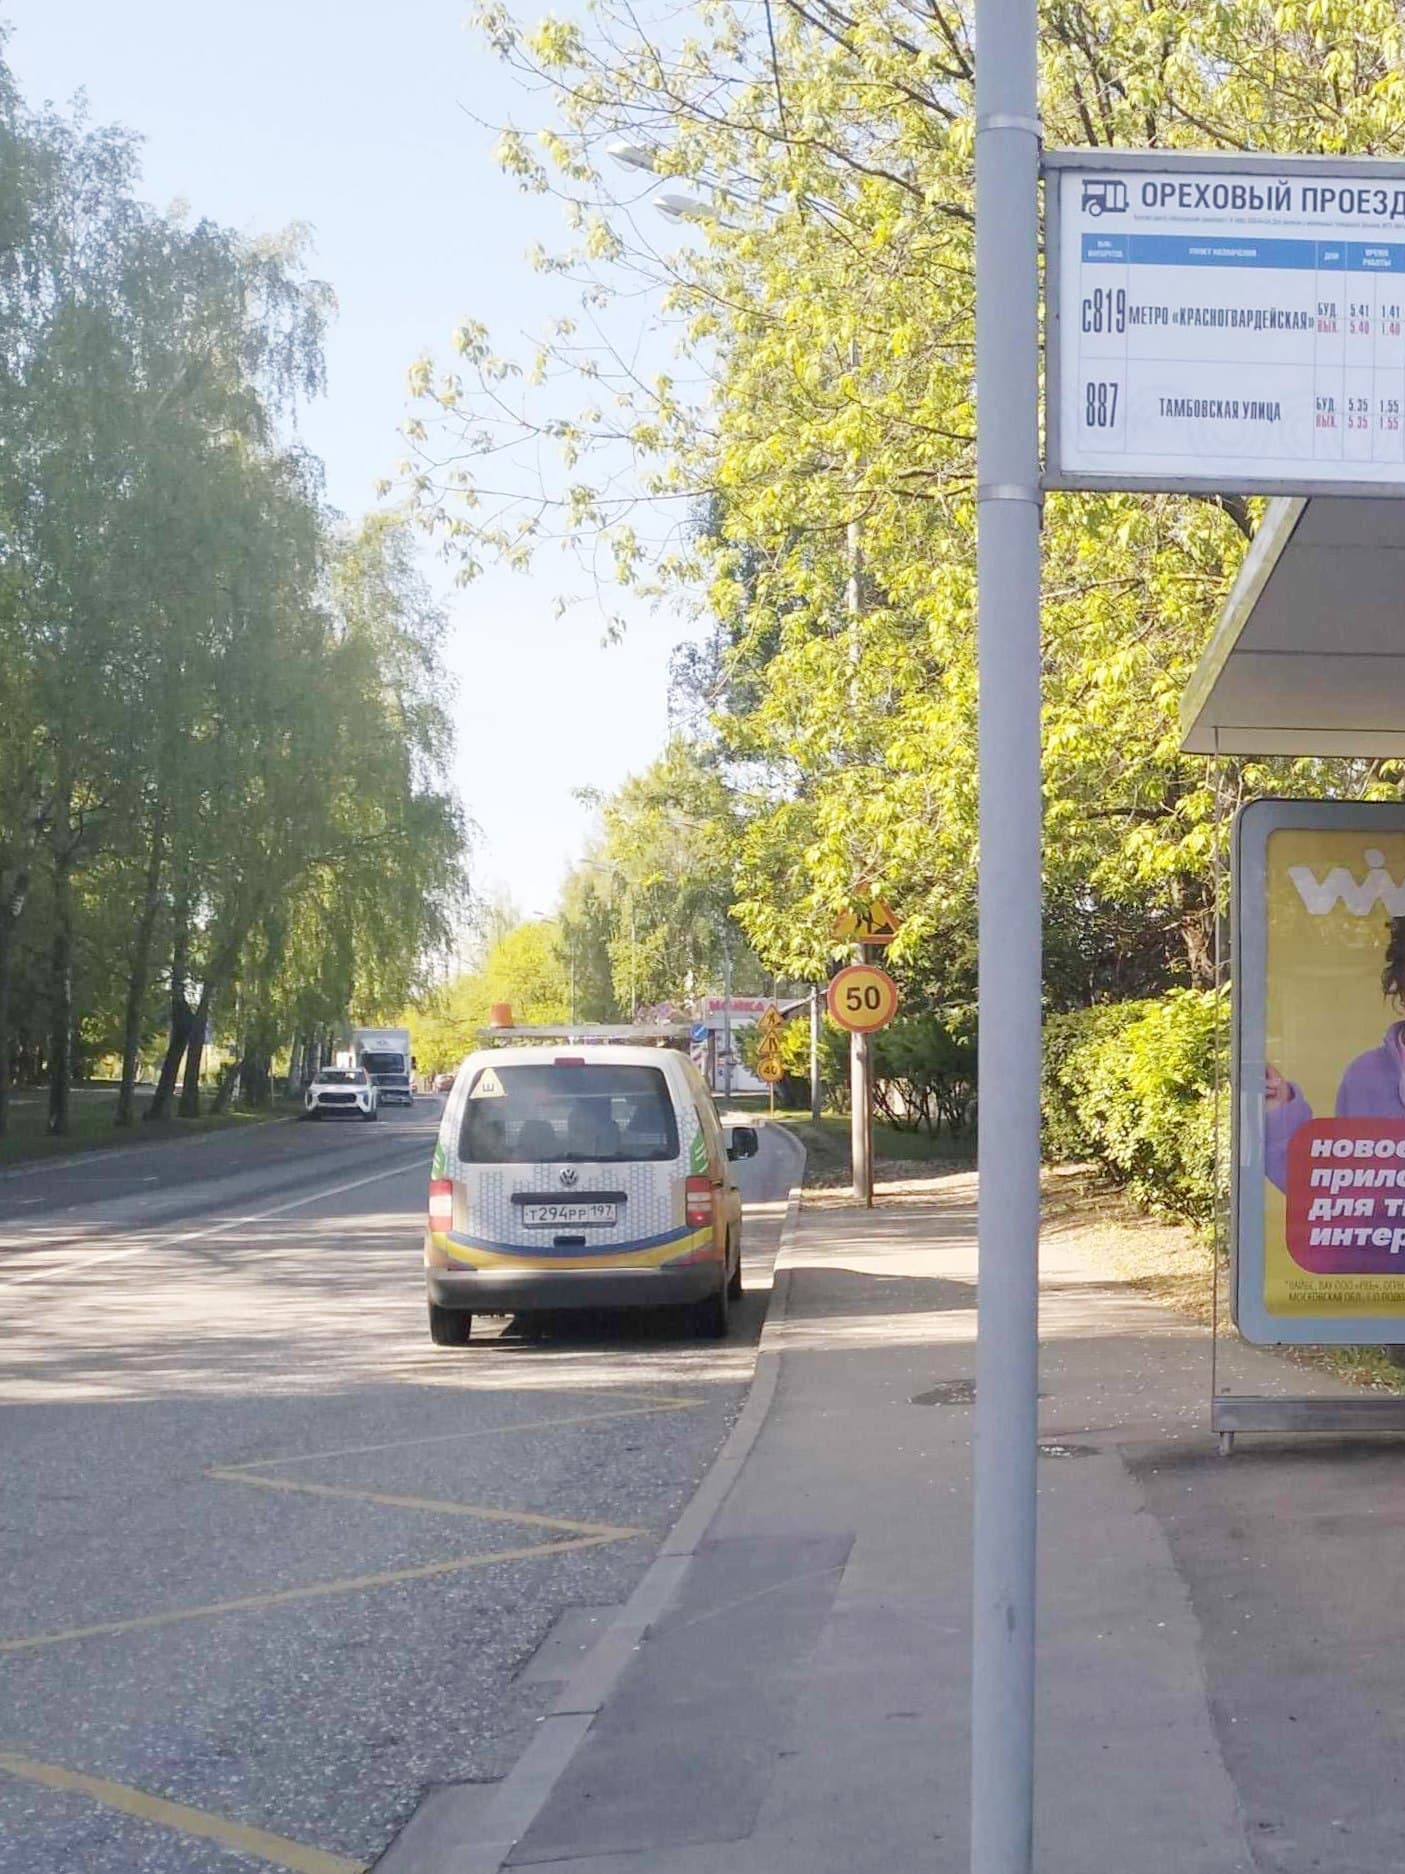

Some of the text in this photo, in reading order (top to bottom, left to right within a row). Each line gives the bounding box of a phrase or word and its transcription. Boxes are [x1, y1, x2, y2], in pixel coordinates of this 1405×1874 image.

[1142, 180, 1291, 211] ОРЕХОВЫЙ
[1082, 288, 1126, 333] с819
[1129, 306, 1315, 330] МЕТРО «КРАСНОГВАРДЕЙСКАЯ»
[1086, 382, 1118, 427] 887
[1159, 398, 1281, 423] ТАМБОВСКАЯ УЛИЦА
[846, 986, 881, 1011] 50
[763, 1064, 777, 1076] 40
[591, 1205, 612, 1216] 197
[1307, 1198, 1375, 1221] для
